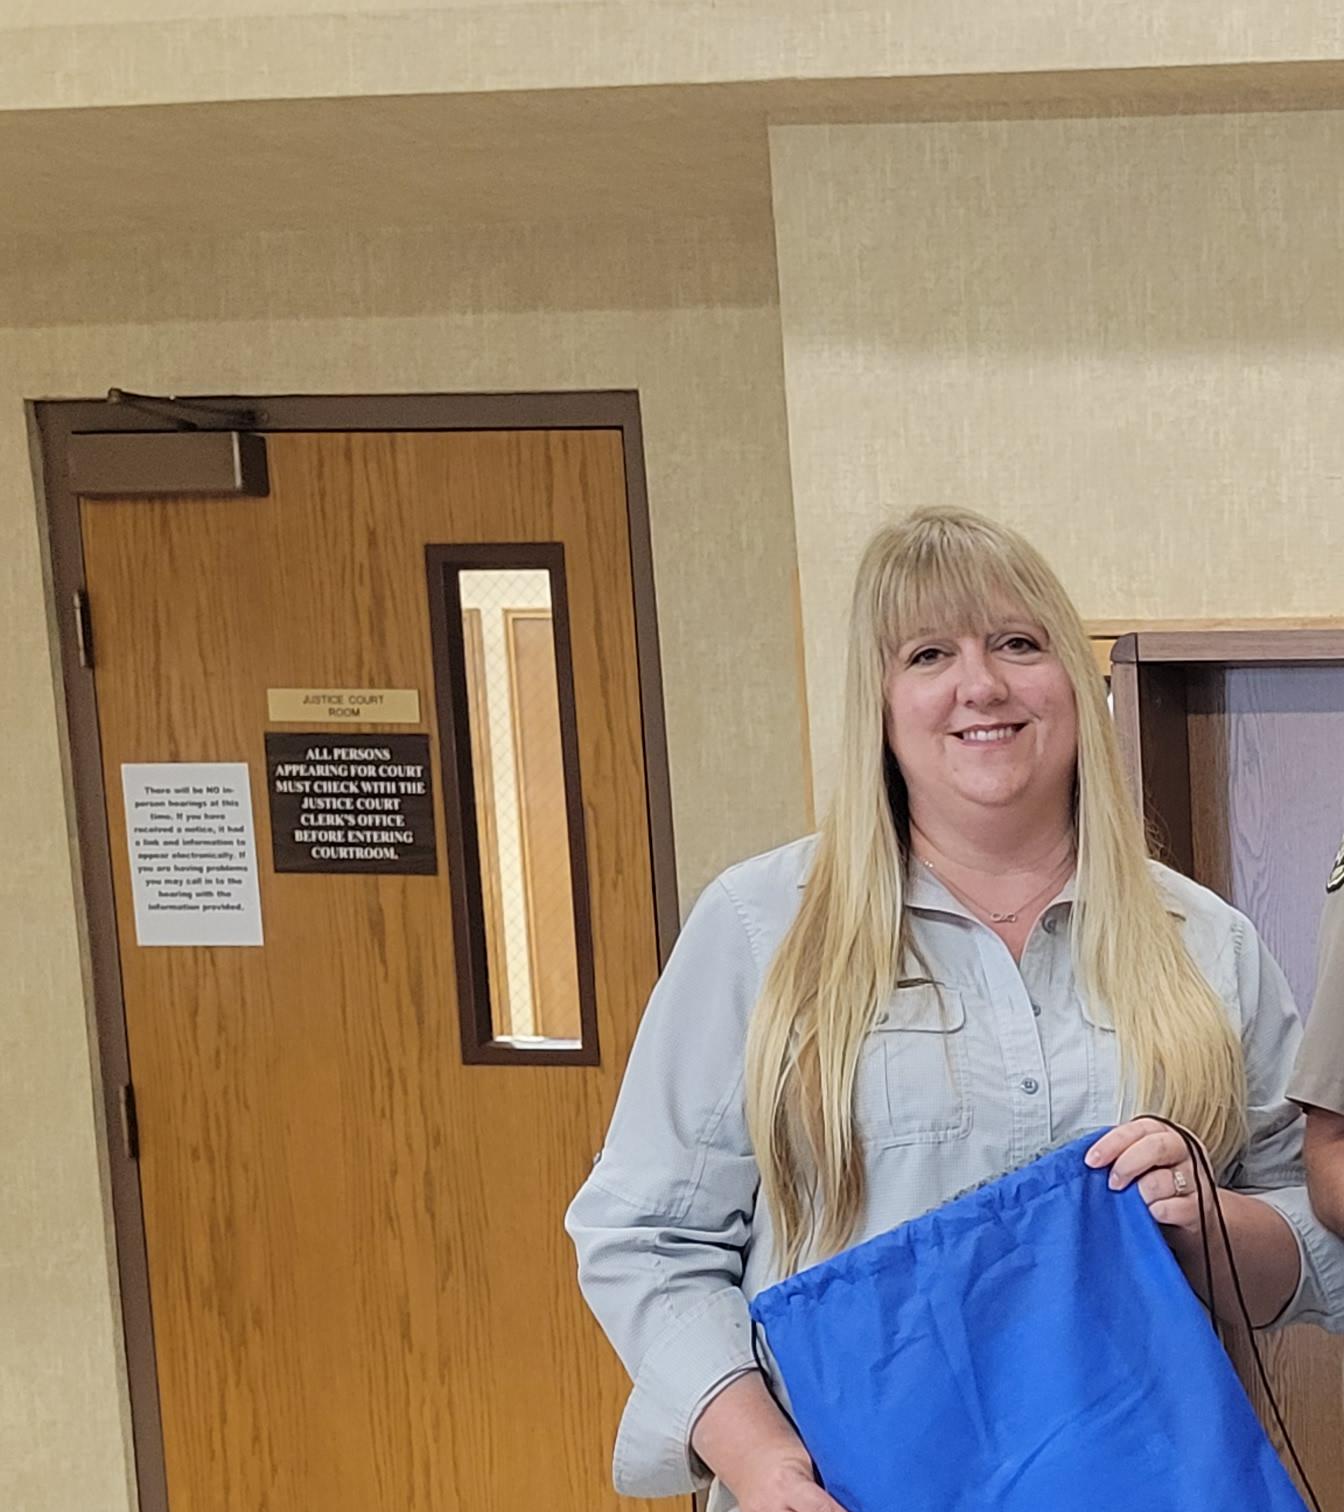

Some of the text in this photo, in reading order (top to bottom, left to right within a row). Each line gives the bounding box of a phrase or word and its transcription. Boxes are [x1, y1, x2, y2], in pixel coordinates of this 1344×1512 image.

[303, 695, 384, 705] JUSTICE COURT
[328, 708, 361, 717] ROOM
[306, 748, 391, 761] ALL PERSONS
[275, 764, 424, 777] APPEARING FOR COURT
[275, 781, 426, 794] MUST CHECK WITH THE
[301, 797, 401, 810] JUSTICE COURT
[300, 814, 405, 827] CLERK'S OFFICE
[294, 830, 414, 843] BEFORE ENTERING
[311, 847, 399, 860] COURTROOM.
